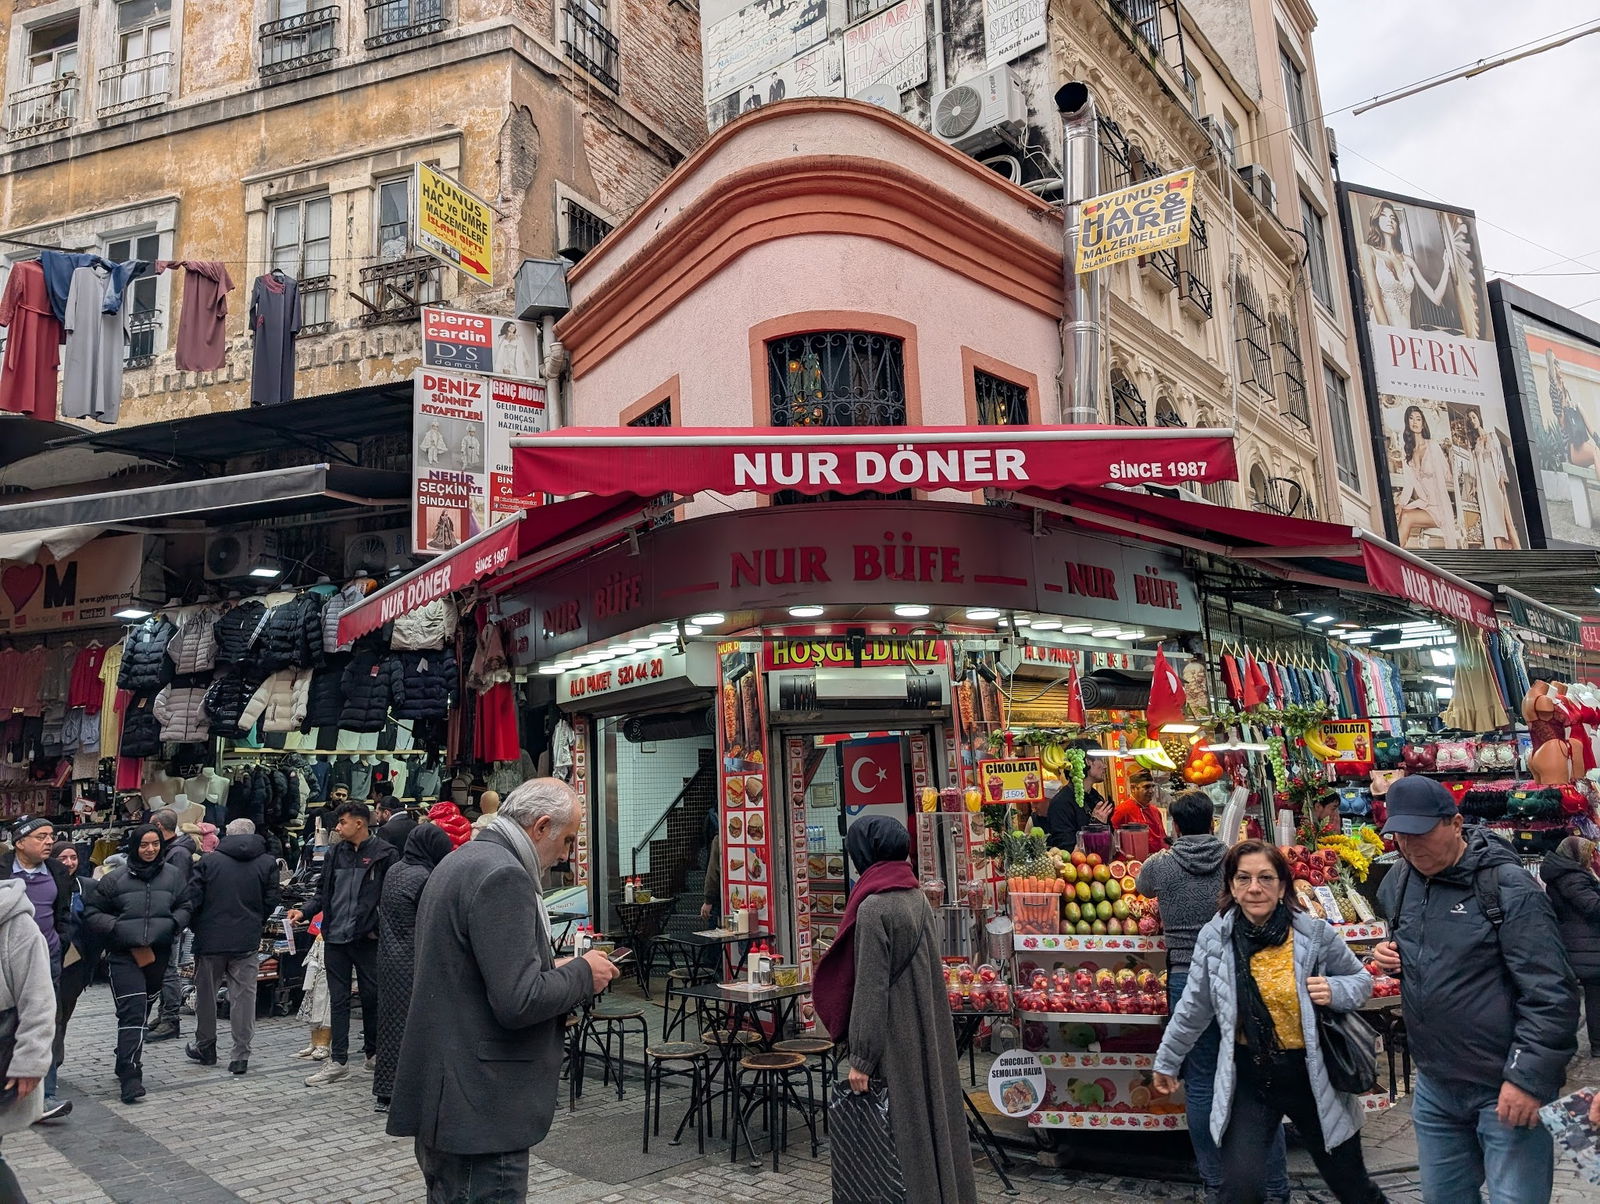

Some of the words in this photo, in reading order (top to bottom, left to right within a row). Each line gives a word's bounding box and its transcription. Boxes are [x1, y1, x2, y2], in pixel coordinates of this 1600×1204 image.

[846, 0, 922, 49] BUHARA
[1023, 30, 1040, 42] HAN
[897, 79, 912, 91] KAT
[920, 73, 925, 81] 1
[431, 175, 481, 217] YUNUS
[1101, 183, 1164, 210] YUNUS
[423, 183, 444, 207] HAC
[447, 202, 458, 216] ve
[461, 209, 487, 236] UMRE
[1083, 199, 1156, 233] HAC
[1160, 192, 1186, 210] &
[426, 202, 484, 245] MALZEMELERİ
[1082, 207, 1186, 247] UMRE
[1113, 246, 1136, 260] GIFTS
[428, 311, 484, 328] pierre
[427, 327, 486, 343] cardin
[434, 360, 479, 369] damat
[423, 374, 481, 399] DENİZ
[492, 379, 517, 400] GENÇ
[518, 385, 545, 403] MODA
[431, 392, 474, 408] SÜNNET
[421, 403, 483, 421] KIYAFETLERİ
[504, 412, 535, 424] BOHÇASI
[518, 403, 543, 416] DAMAT
[498, 421, 541, 434] HAZIRLANIR
[733, 452, 841, 486] NUR
[855, 444, 1030, 484] DÖNER
[1109, 460, 1163, 479] SİNCE
[1167, 461, 1207, 477] 1987
[428, 469, 475, 484] NEHİR
[419, 481, 467, 496] SEÇKİN
[419, 494, 468, 509] BİNDALLI
[729, 546, 832, 589] NUR
[854, 530, 965, 585] BÜFE
[381, 588, 405, 623] NUR
[407, 564, 452, 609] DÖNER
[494, 547, 509, 566] 1987
[1065, 561, 1119, 600] NUR
[1134, 565, 1182, 611] BÜFE
[1400, 565, 1434, 606] NUR
[1432, 577, 1474, 622] DÖNER
[543, 600, 582, 635] NUR
[594, 571, 642, 620] BÜFE
[719, 641, 733, 654] NUR
[733, 641, 742, 651] D
[570, 676, 586, 698] ALO
[587, 670, 612, 694] PAKET
[618, 664, 634, 686] 520
[634, 663, 648, 681] 44
[650, 658, 664, 679] 20
[1323, 723, 1367, 735] ÇİKOLATA
[985, 762, 1038, 775] ÇİKOLATA
[1000, 1056, 1035, 1067] CHOCOLATE
[1023, 1066, 1043, 1076] HALVA
